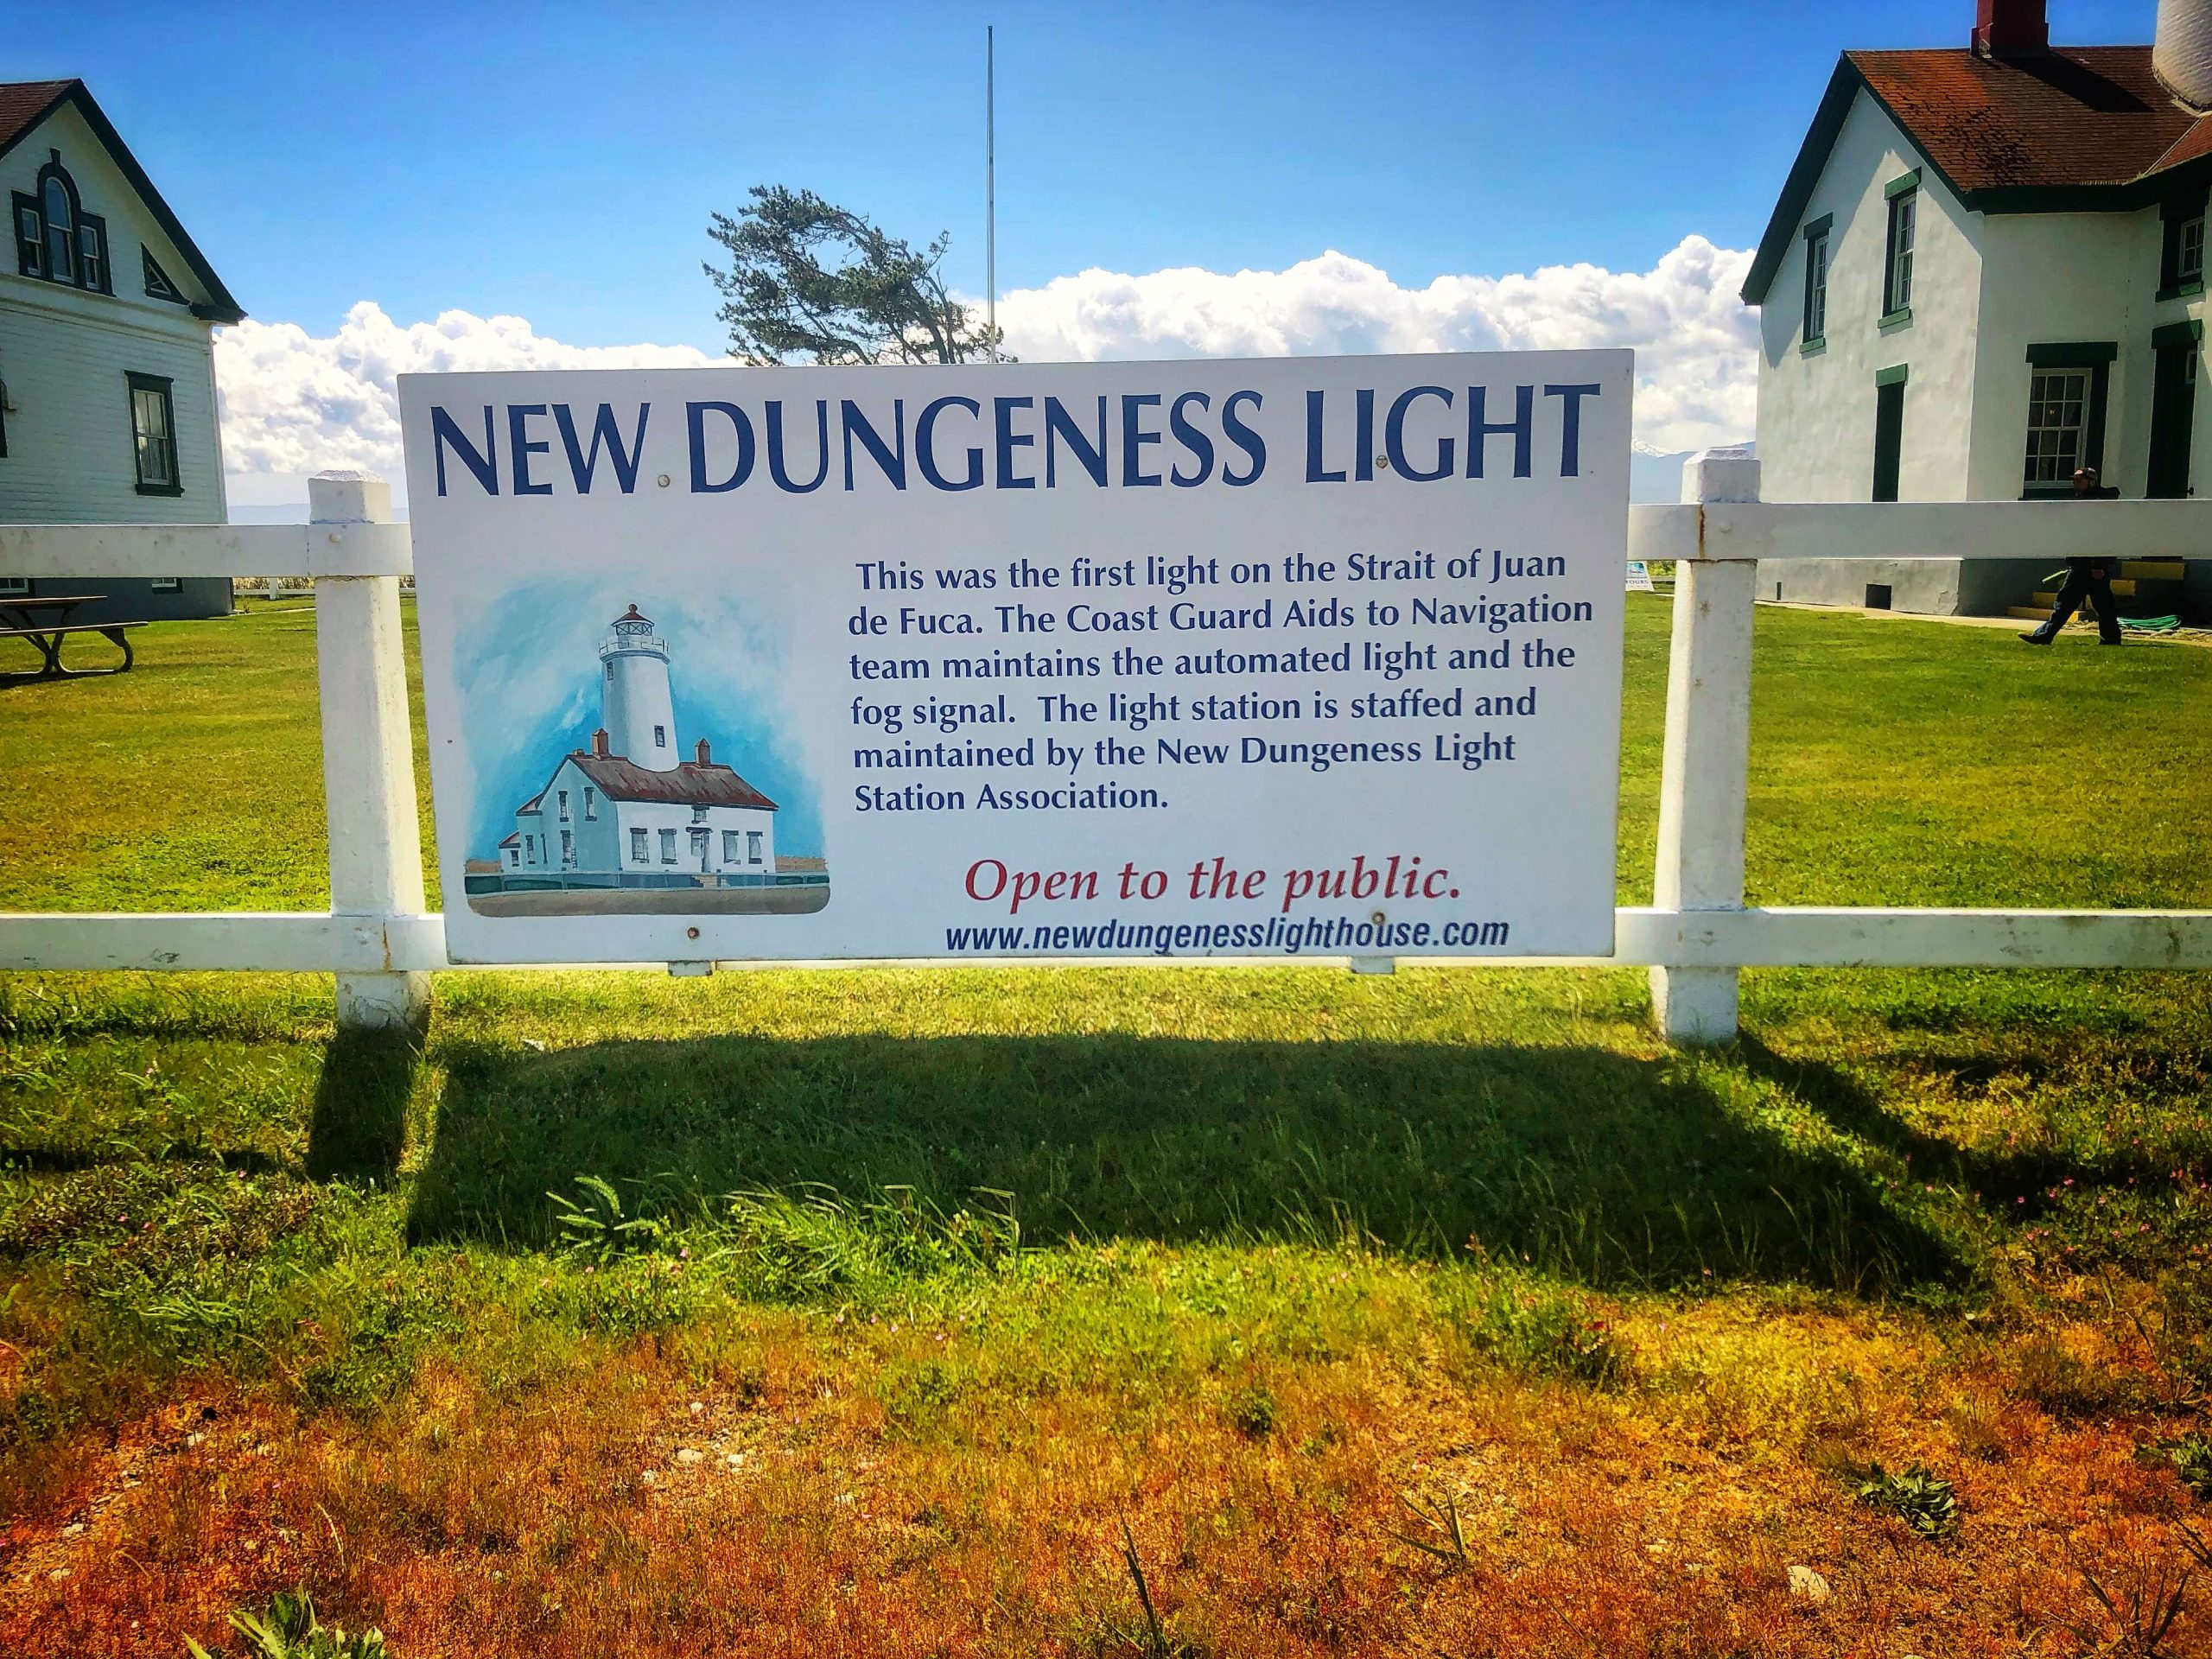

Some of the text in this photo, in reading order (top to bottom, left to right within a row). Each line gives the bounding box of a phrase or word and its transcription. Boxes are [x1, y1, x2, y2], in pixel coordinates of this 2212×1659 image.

[431, 383, 1601, 498] NEW DUNGENESS LIGHT
[855, 548, 1566, 595] This was the first light on the Strait of Juan
[849, 593, 1592, 636] de Fuca. The Coast Guard Aids to Navigation
[849, 638, 1576, 681] team maintains the automated light and the
[849, 686, 1537, 734] fog signal. The light station is staffed and
[854, 731, 1516, 776] maintained by the New Dungeness Light
[855, 780, 1168, 812] Station Association.
[964, 855, 1460, 916] Open to the public.
[945, 916, 1510, 954] www.newdungenesslighthouse.com
